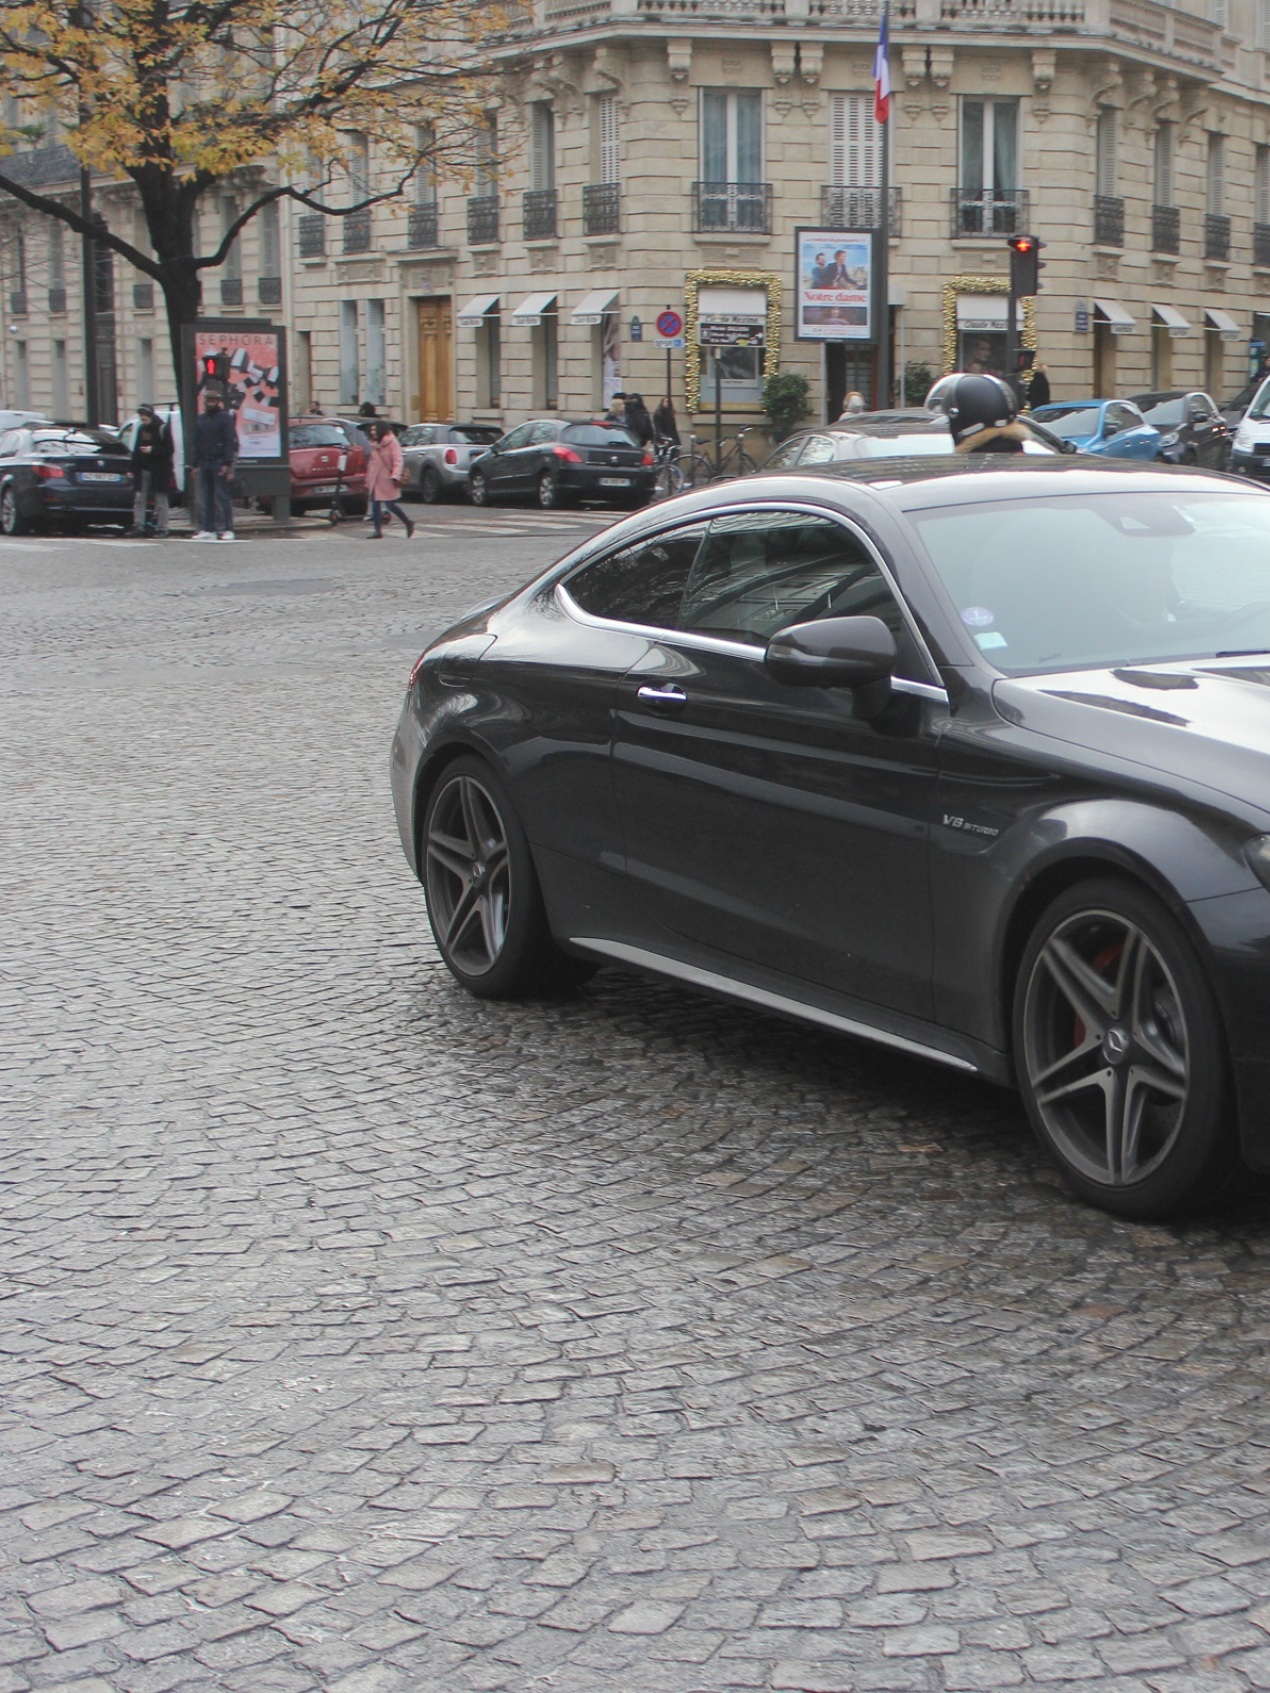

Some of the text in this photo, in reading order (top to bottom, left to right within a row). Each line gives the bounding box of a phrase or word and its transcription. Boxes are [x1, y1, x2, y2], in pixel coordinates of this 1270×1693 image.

[804, 290, 867, 303] Notre dame
[199, 334, 274, 346] SEPHORA
[943, 814, 964, 827] V8
